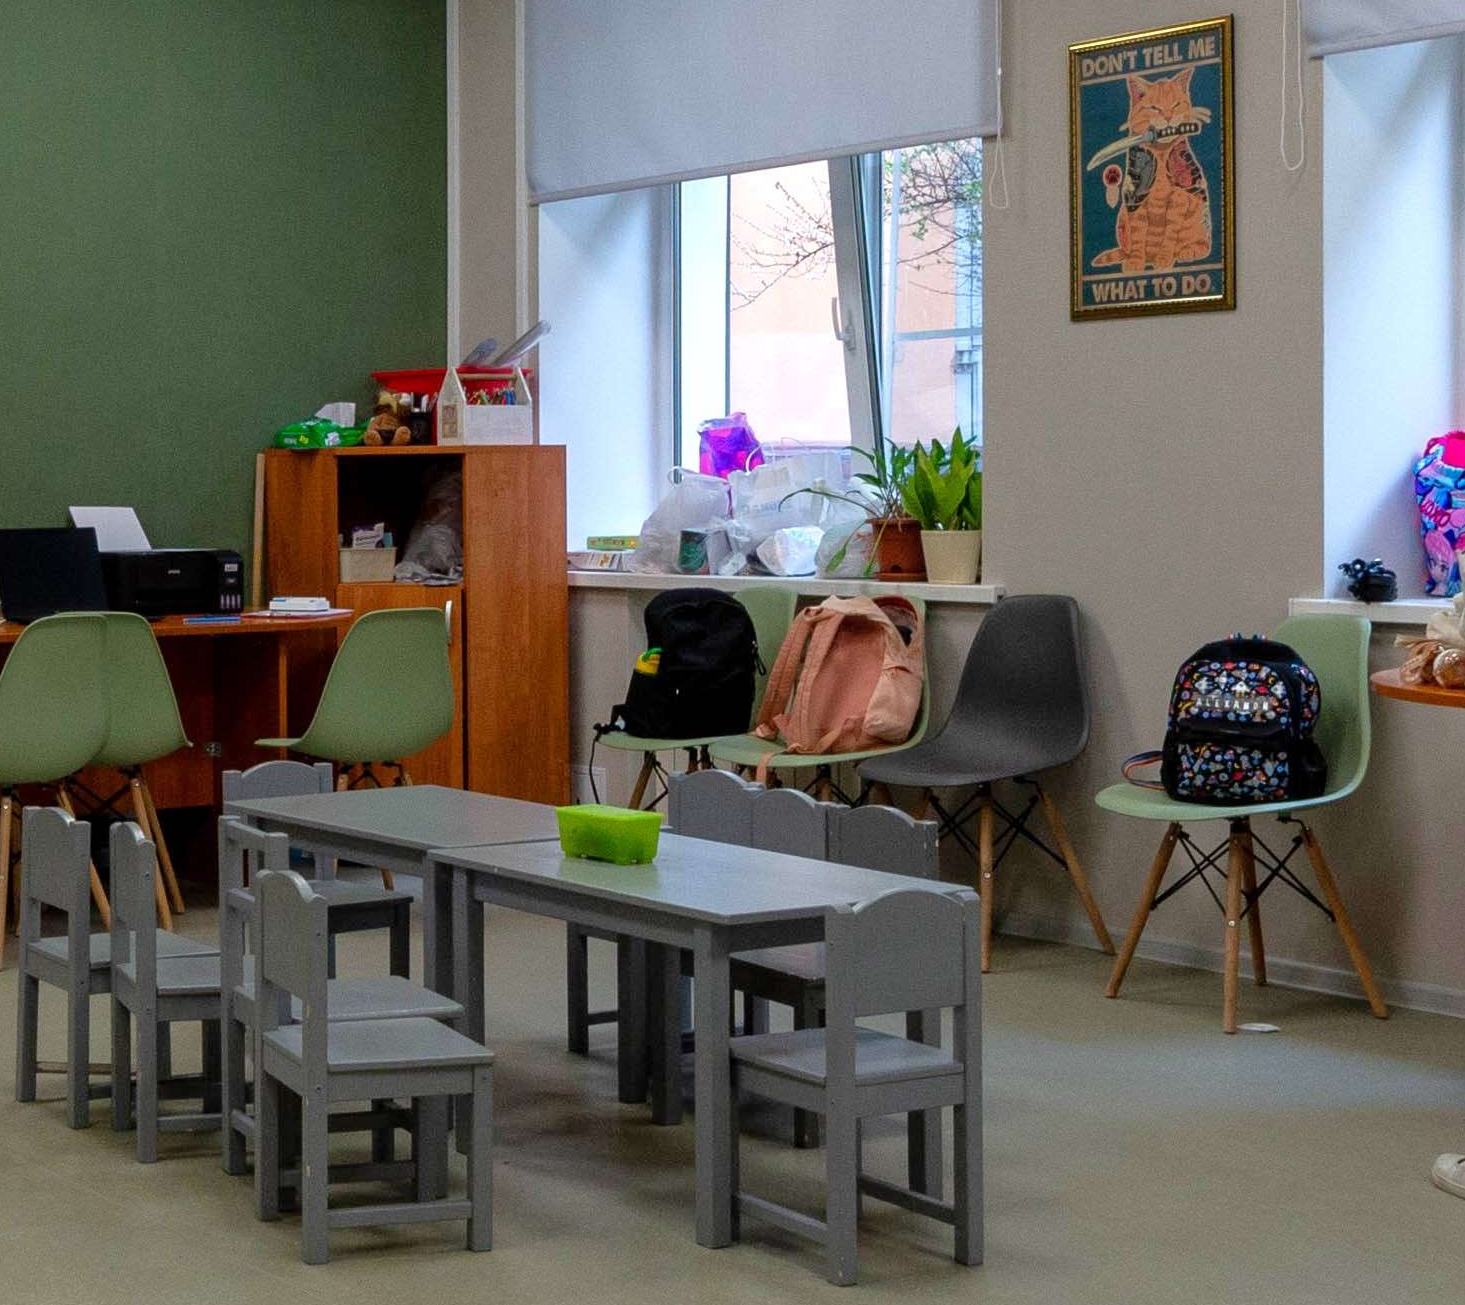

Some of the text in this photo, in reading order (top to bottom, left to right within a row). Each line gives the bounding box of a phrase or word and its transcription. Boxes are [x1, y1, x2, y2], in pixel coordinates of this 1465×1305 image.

[1082, 37, 1215, 78] DON'T TELL ME
[1093, 274, 1212, 303] WHAT TO DO
